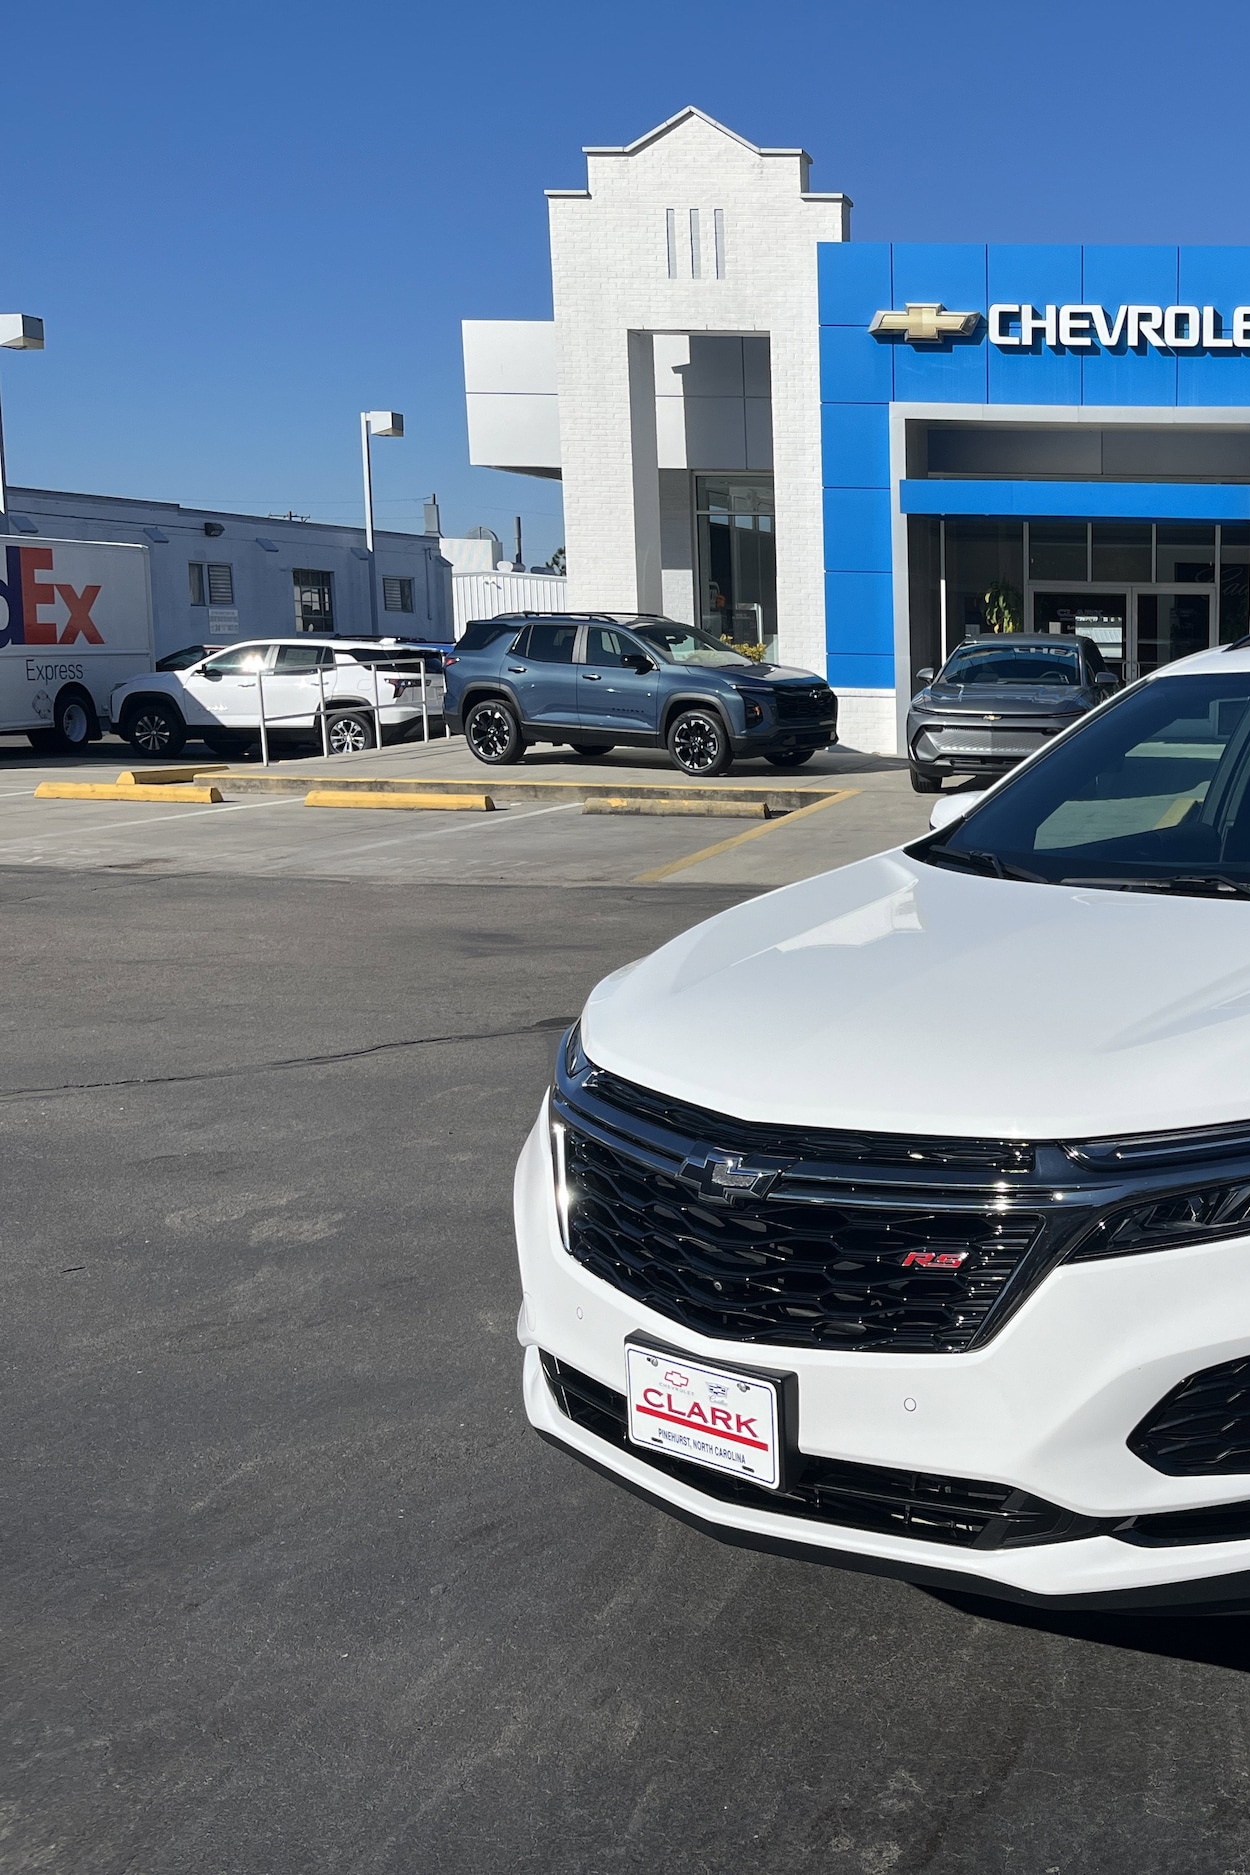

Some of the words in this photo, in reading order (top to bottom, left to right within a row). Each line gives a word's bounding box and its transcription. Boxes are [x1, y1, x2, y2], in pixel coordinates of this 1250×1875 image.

[26, 659, 84, 686] Express
[902, 1251, 968, 1268] RS
[658, 1382, 695, 1396] CHEVROLET
[643, 1388, 758, 1438] CLARK
[658, 1428, 692, 1449] PINEHURST,
[692, 1440, 714, 1455] NORTH
[714, 1446, 746, 1465] CAROLINA
